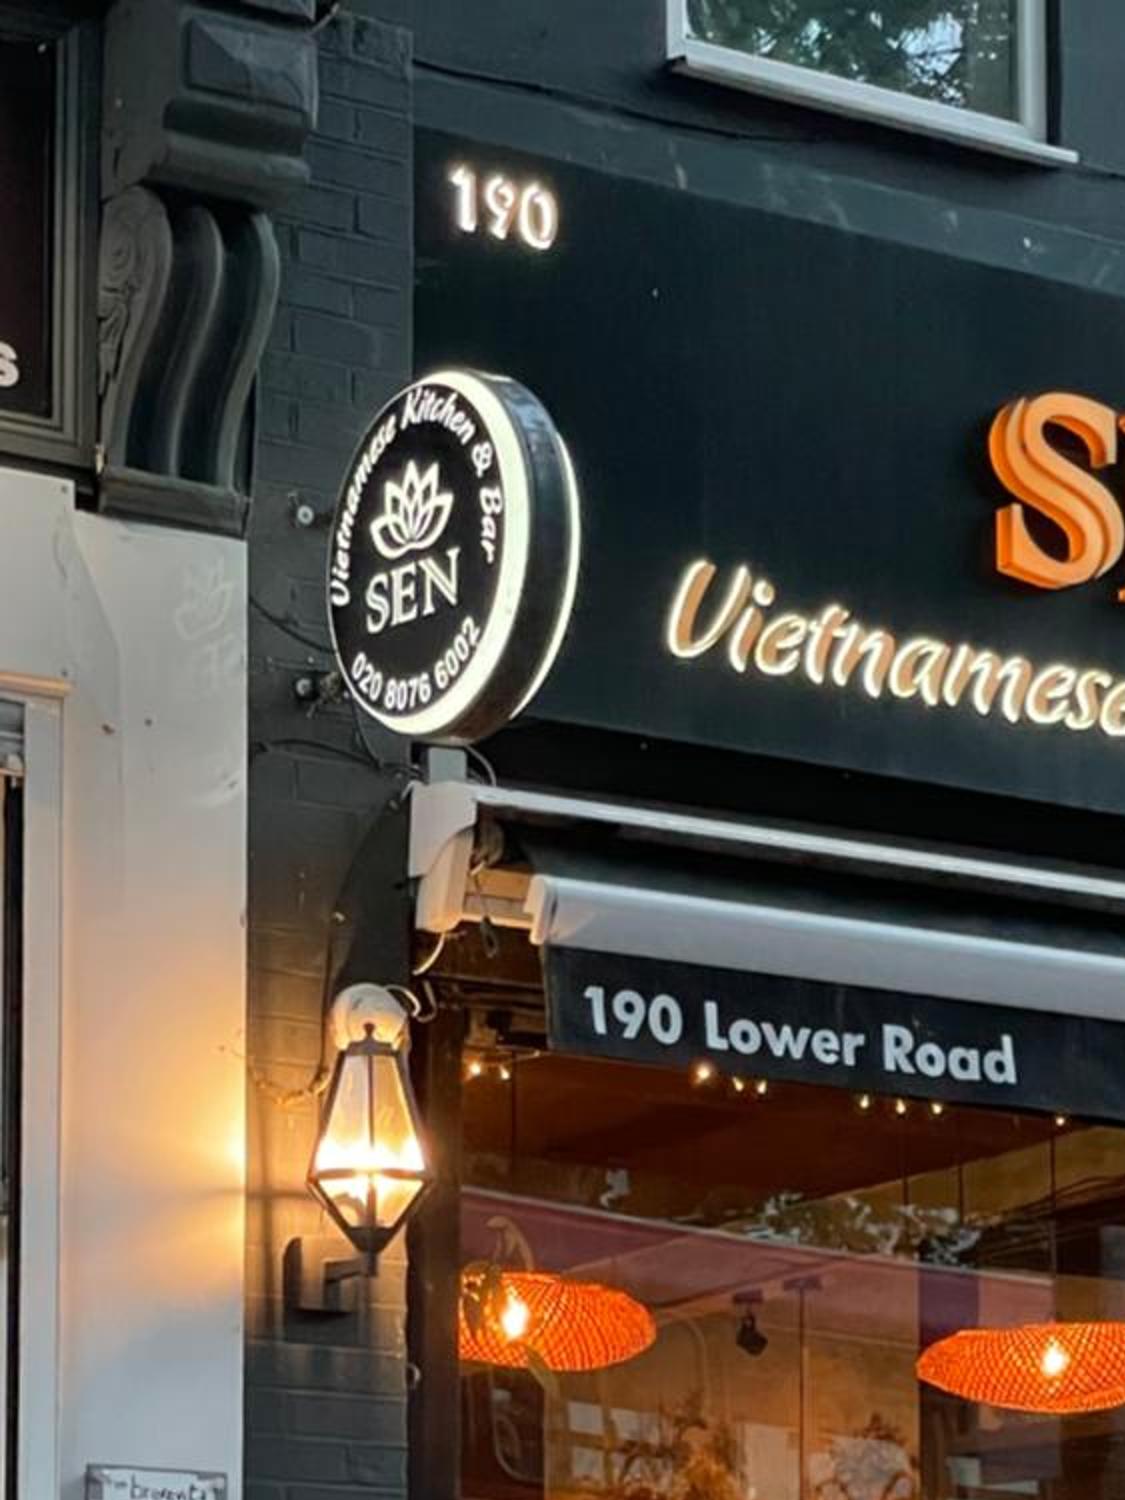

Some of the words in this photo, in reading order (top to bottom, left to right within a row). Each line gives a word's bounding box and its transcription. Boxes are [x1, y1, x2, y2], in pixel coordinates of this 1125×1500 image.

[448, 161, 559, 250] 190
[401, 386, 475, 444] Kitchen
[471, 443, 494, 478] &
[330, 414, 395, 608] Vietnamese
[479, 486, 504, 563] Bar
[365, 547, 461, 635] SEN
[351, 652, 382, 701] 020
[385, 673, 431, 710] 8076
[434, 616, 481, 689] 6002
[584, 985, 682, 1045] 190
[704, 1001, 865, 1066] Lower
[882, 1023, 1016, 1085] Road
